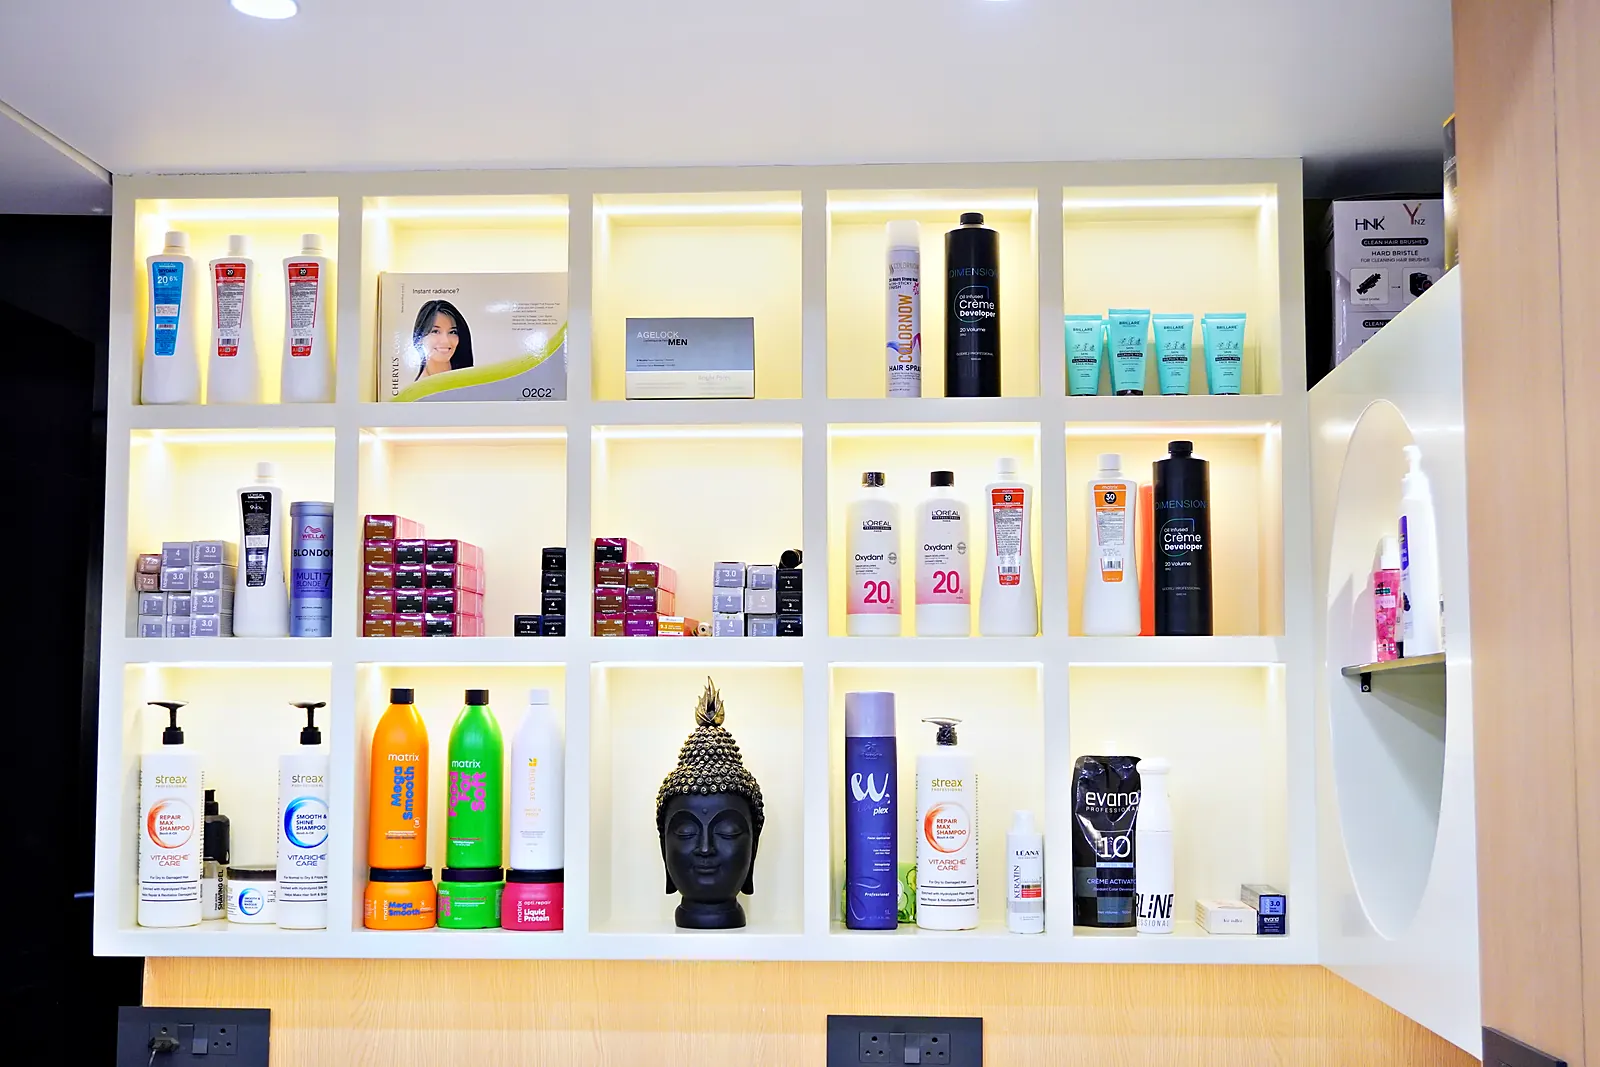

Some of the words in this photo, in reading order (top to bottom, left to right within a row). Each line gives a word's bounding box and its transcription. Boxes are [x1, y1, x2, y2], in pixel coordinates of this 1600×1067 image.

[1355, 216, 1385, 231] HNK
[157, 276, 168, 284] 20
[959, 298, 995, 310] Crème
[960, 310, 996, 318] Developer
[898, 294, 913, 363] COLORNOW
[668, 338, 688, 346] MEN
[888, 364, 904, 372] HAIR
[522, 388, 552, 398] O2C2
[1164, 532, 1201, 542] Crème
[924, 544, 952, 552] Oxydant
[1165, 543, 1202, 551] Developer
[855, 554, 884, 562] Oxydant
[296, 572, 322, 580] MULTI
[932, 570, 960, 594] 20
[864, 580, 890, 604] 20
[388, 753, 419, 761] matrix
[452, 760, 481, 768] matrix
[155, 775, 187, 784] streax
[292, 774, 324, 784] streax
[931, 778, 962, 788] streax
[391, 766, 404, 806] Mega
[458, 771, 470, 800] For
[403, 766, 414, 820] Smooth
[471, 771, 486, 812] Soft
[873, 807, 889, 816] plex
[1100, 836, 1131, 858] 10
[388, 902, 412, 910] Mega
[524, 908, 546, 916] Liquid
